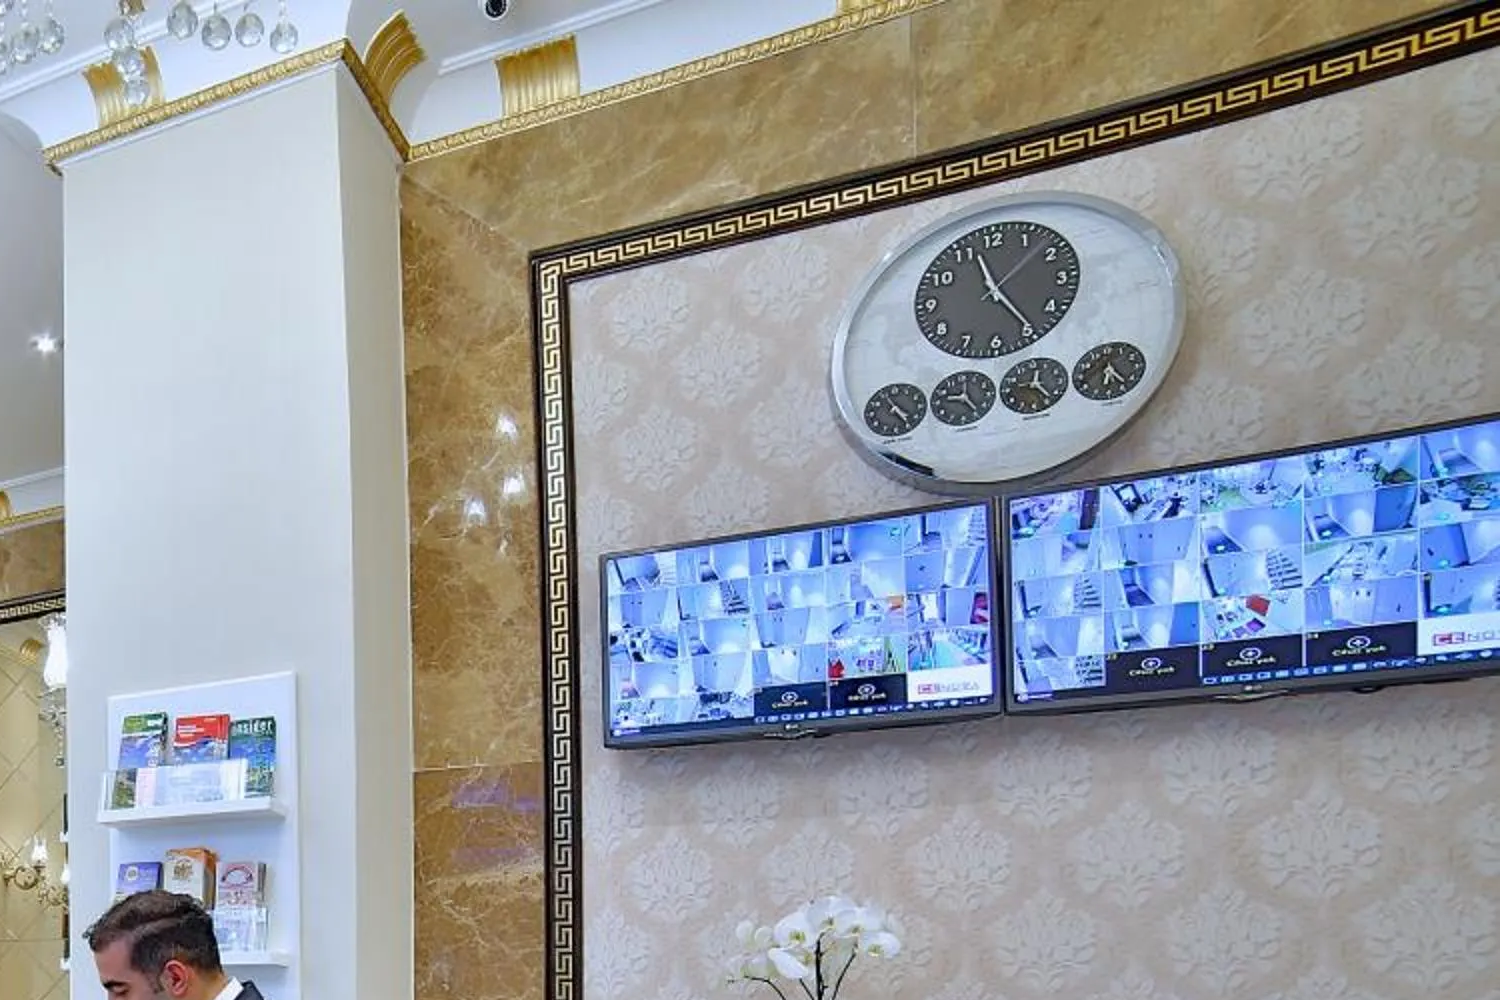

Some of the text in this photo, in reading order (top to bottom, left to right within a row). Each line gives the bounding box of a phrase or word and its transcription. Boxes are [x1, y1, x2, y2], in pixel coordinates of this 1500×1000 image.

[983, 233, 1003, 248] 12
[953, 247, 973, 263] 11
[1045, 247, 1057, 261] 2
[932, 271, 953, 287] 10
[1056, 271, 1067, 284] 3
[925, 298, 937, 312] 9
[1043, 299, 1056, 312] 4
[936, 323, 947, 335] 8
[1021, 323, 1034, 337] 5
[960, 335, 972, 347] 7
[990, 335, 1002, 349] 6
